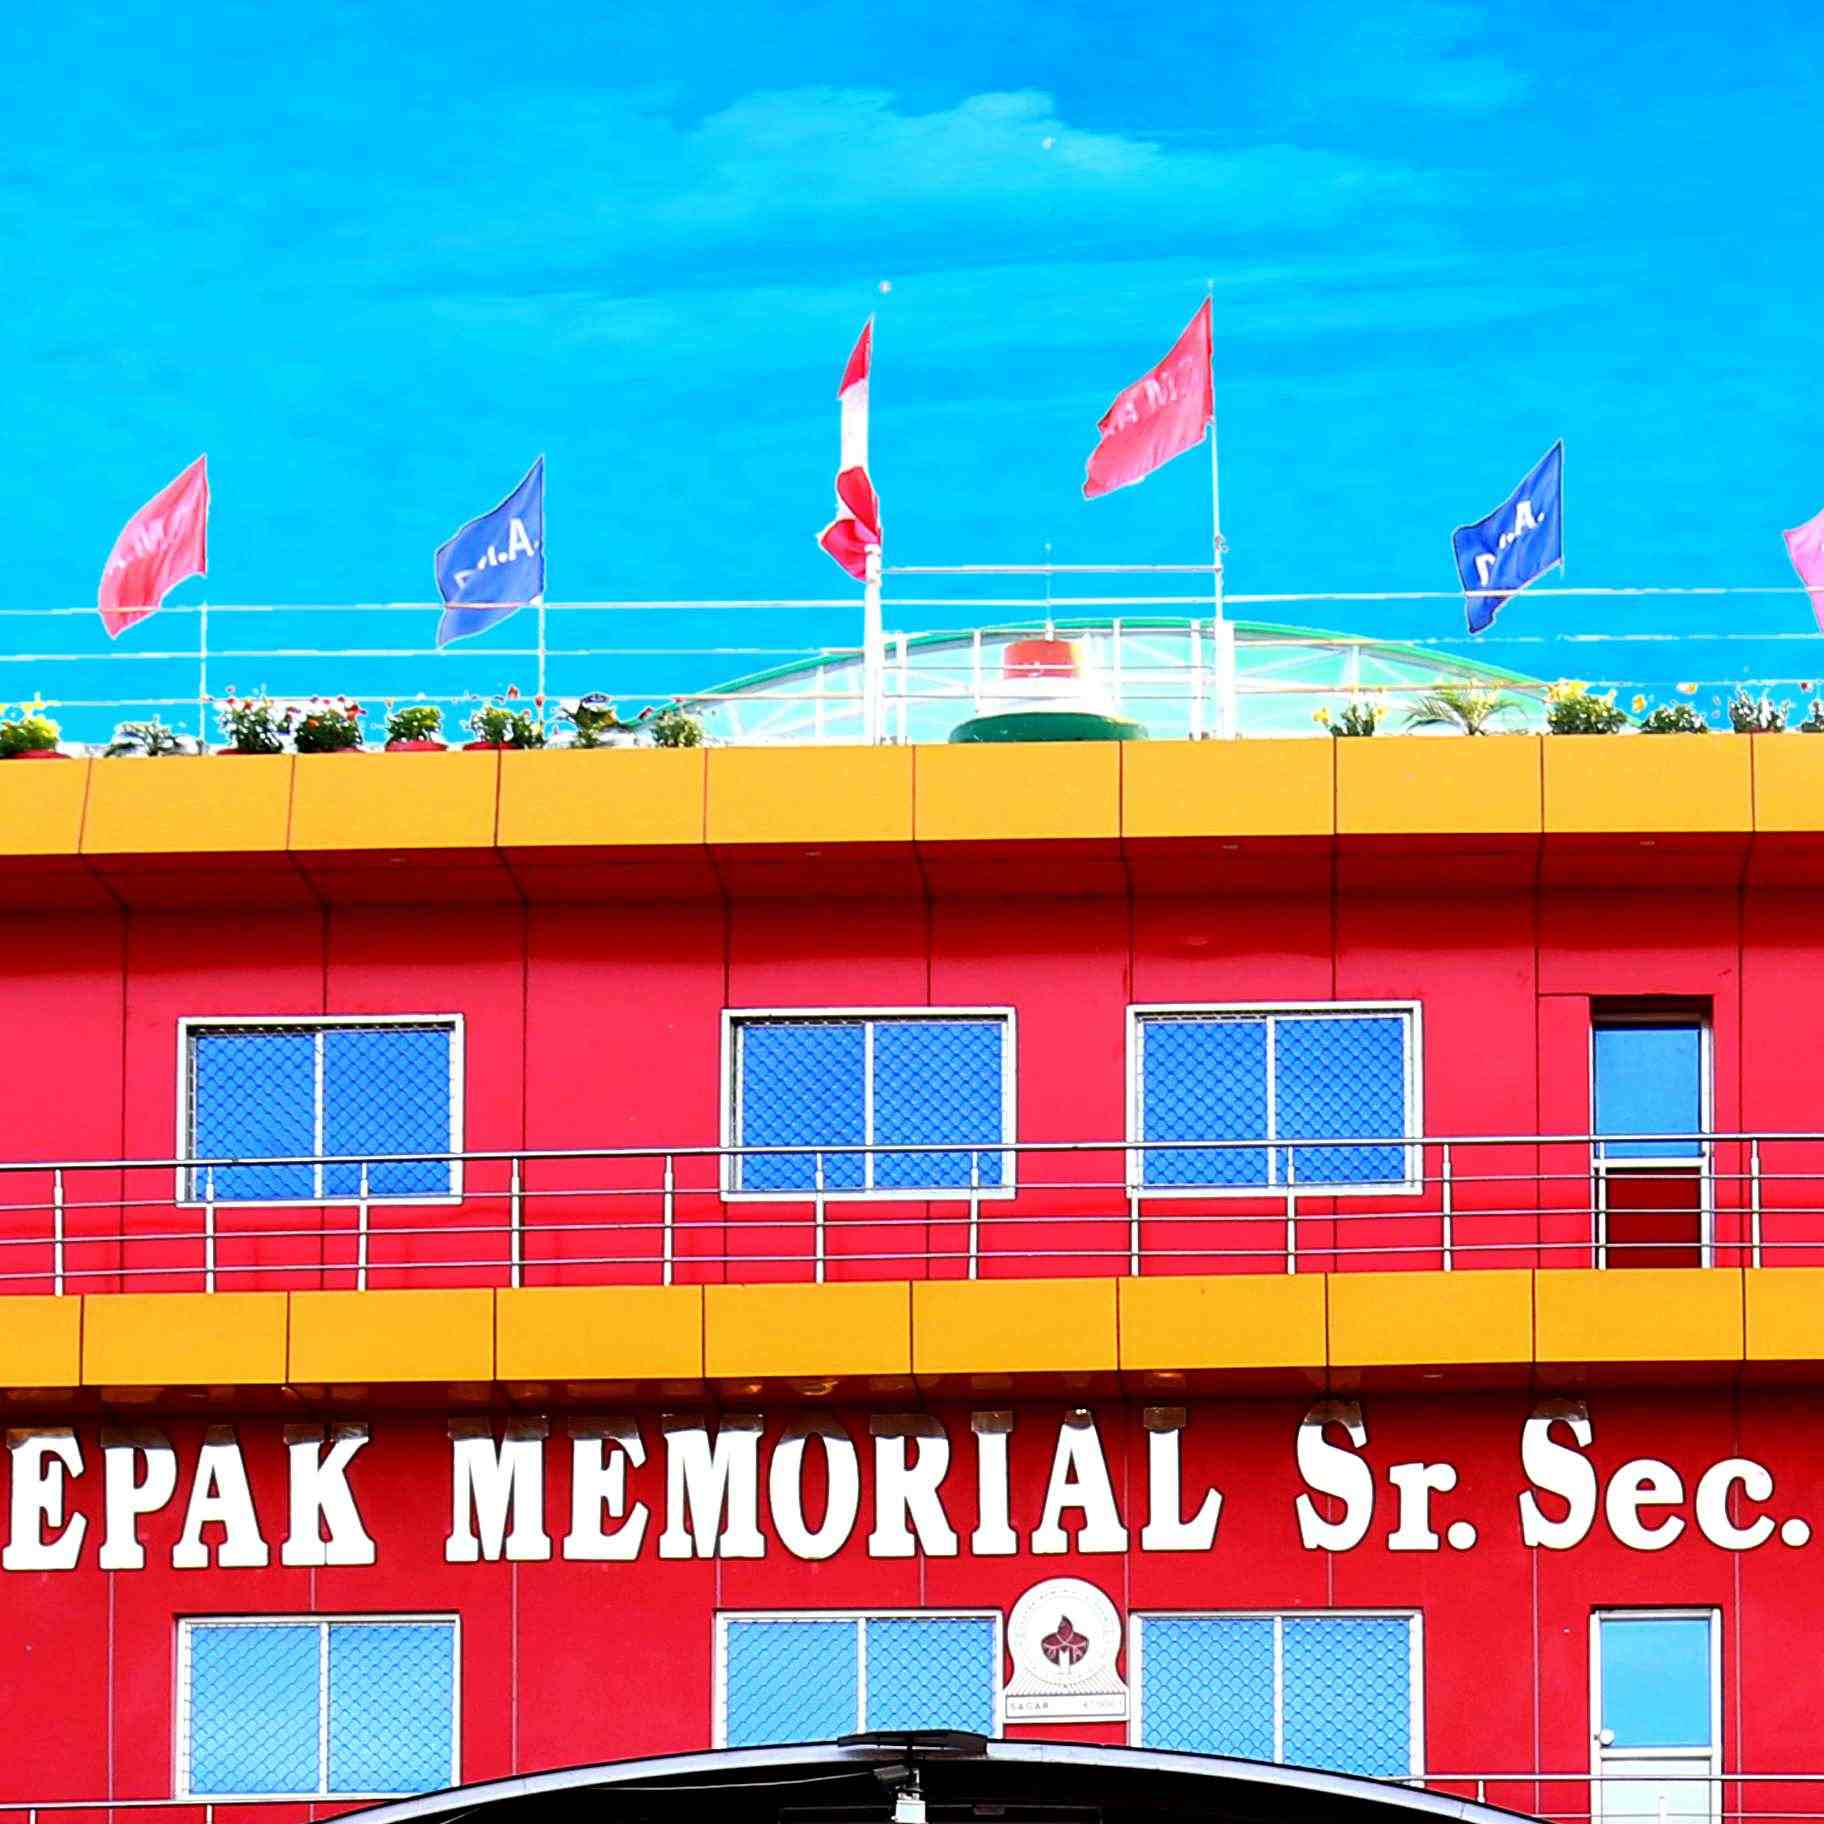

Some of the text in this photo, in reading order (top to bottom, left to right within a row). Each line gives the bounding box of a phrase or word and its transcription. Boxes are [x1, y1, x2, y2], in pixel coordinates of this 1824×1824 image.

[445, 1406, 1223, 1562] MEMORIAL
[1296, 1400, 1476, 1551] Sr.
[1519, 1399, 1811, 1551] Sec.
